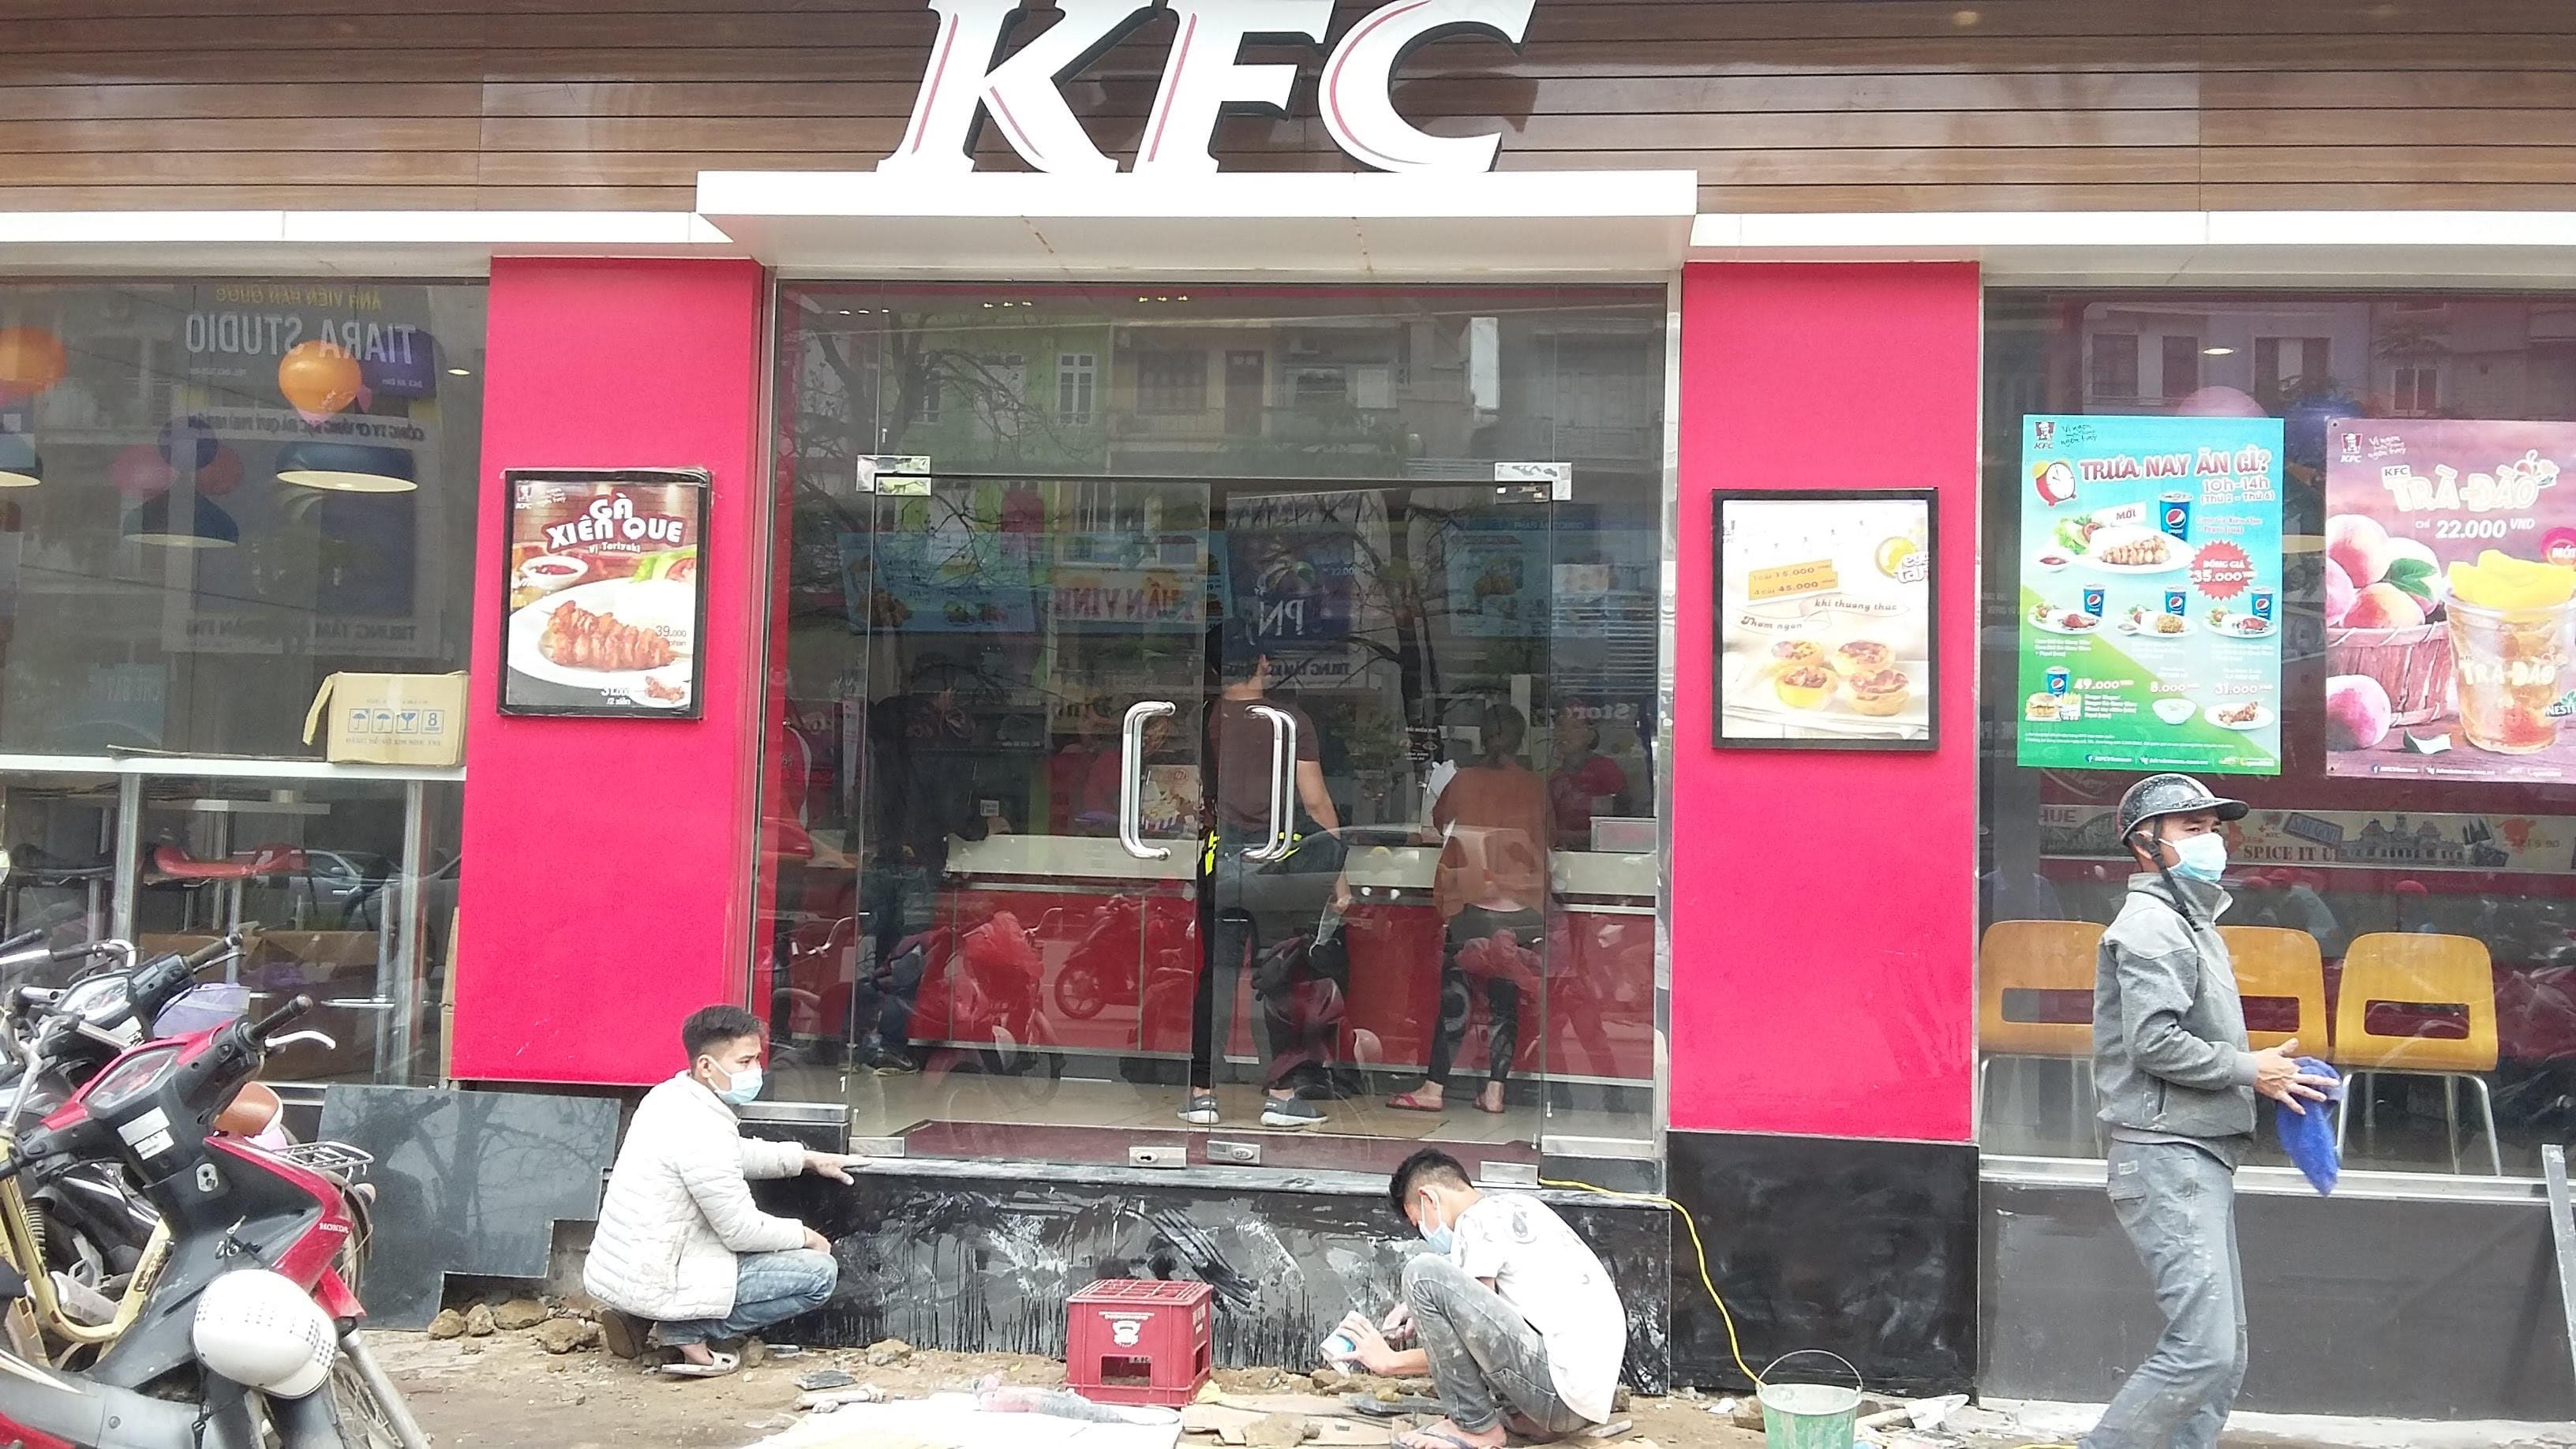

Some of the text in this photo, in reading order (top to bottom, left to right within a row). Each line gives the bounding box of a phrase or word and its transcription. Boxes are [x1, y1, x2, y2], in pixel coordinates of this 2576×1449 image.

[877, 0, 1537, 173] KFC
[2080, 444, 2271, 481] TRƯA NAY ĂN GÌ?
[2340, 455, 2362, 463] KFC
[2384, 467, 2408, 477] KFC
[2203, 476, 2269, 492] 10h-14h
[2385, 464, 2539, 511] TRÀ-ĐÀO
[589, 492, 634, 520] GÀ
[546, 514, 683, 549] XIÊN QUE
[2435, 519, 2507, 539] 22.000
[601, 541, 641, 553] Teriyaki
[1776, 567, 1814, 578] 15.000
[2194, 568, 2243, 582] 35.000
[1778, 581, 1818, 593] 45.000
[1814, 598, 1831, 608] khi
[656, 625, 687, 638] 39.000
[2074, 677, 2120, 690] 49.000
[428, 712, 438, 727] 8
[2243, 844, 2293, 860] SPICE
[2297, 846, 2317, 861] IT
[319, 1222, 350, 1234] HONDA
